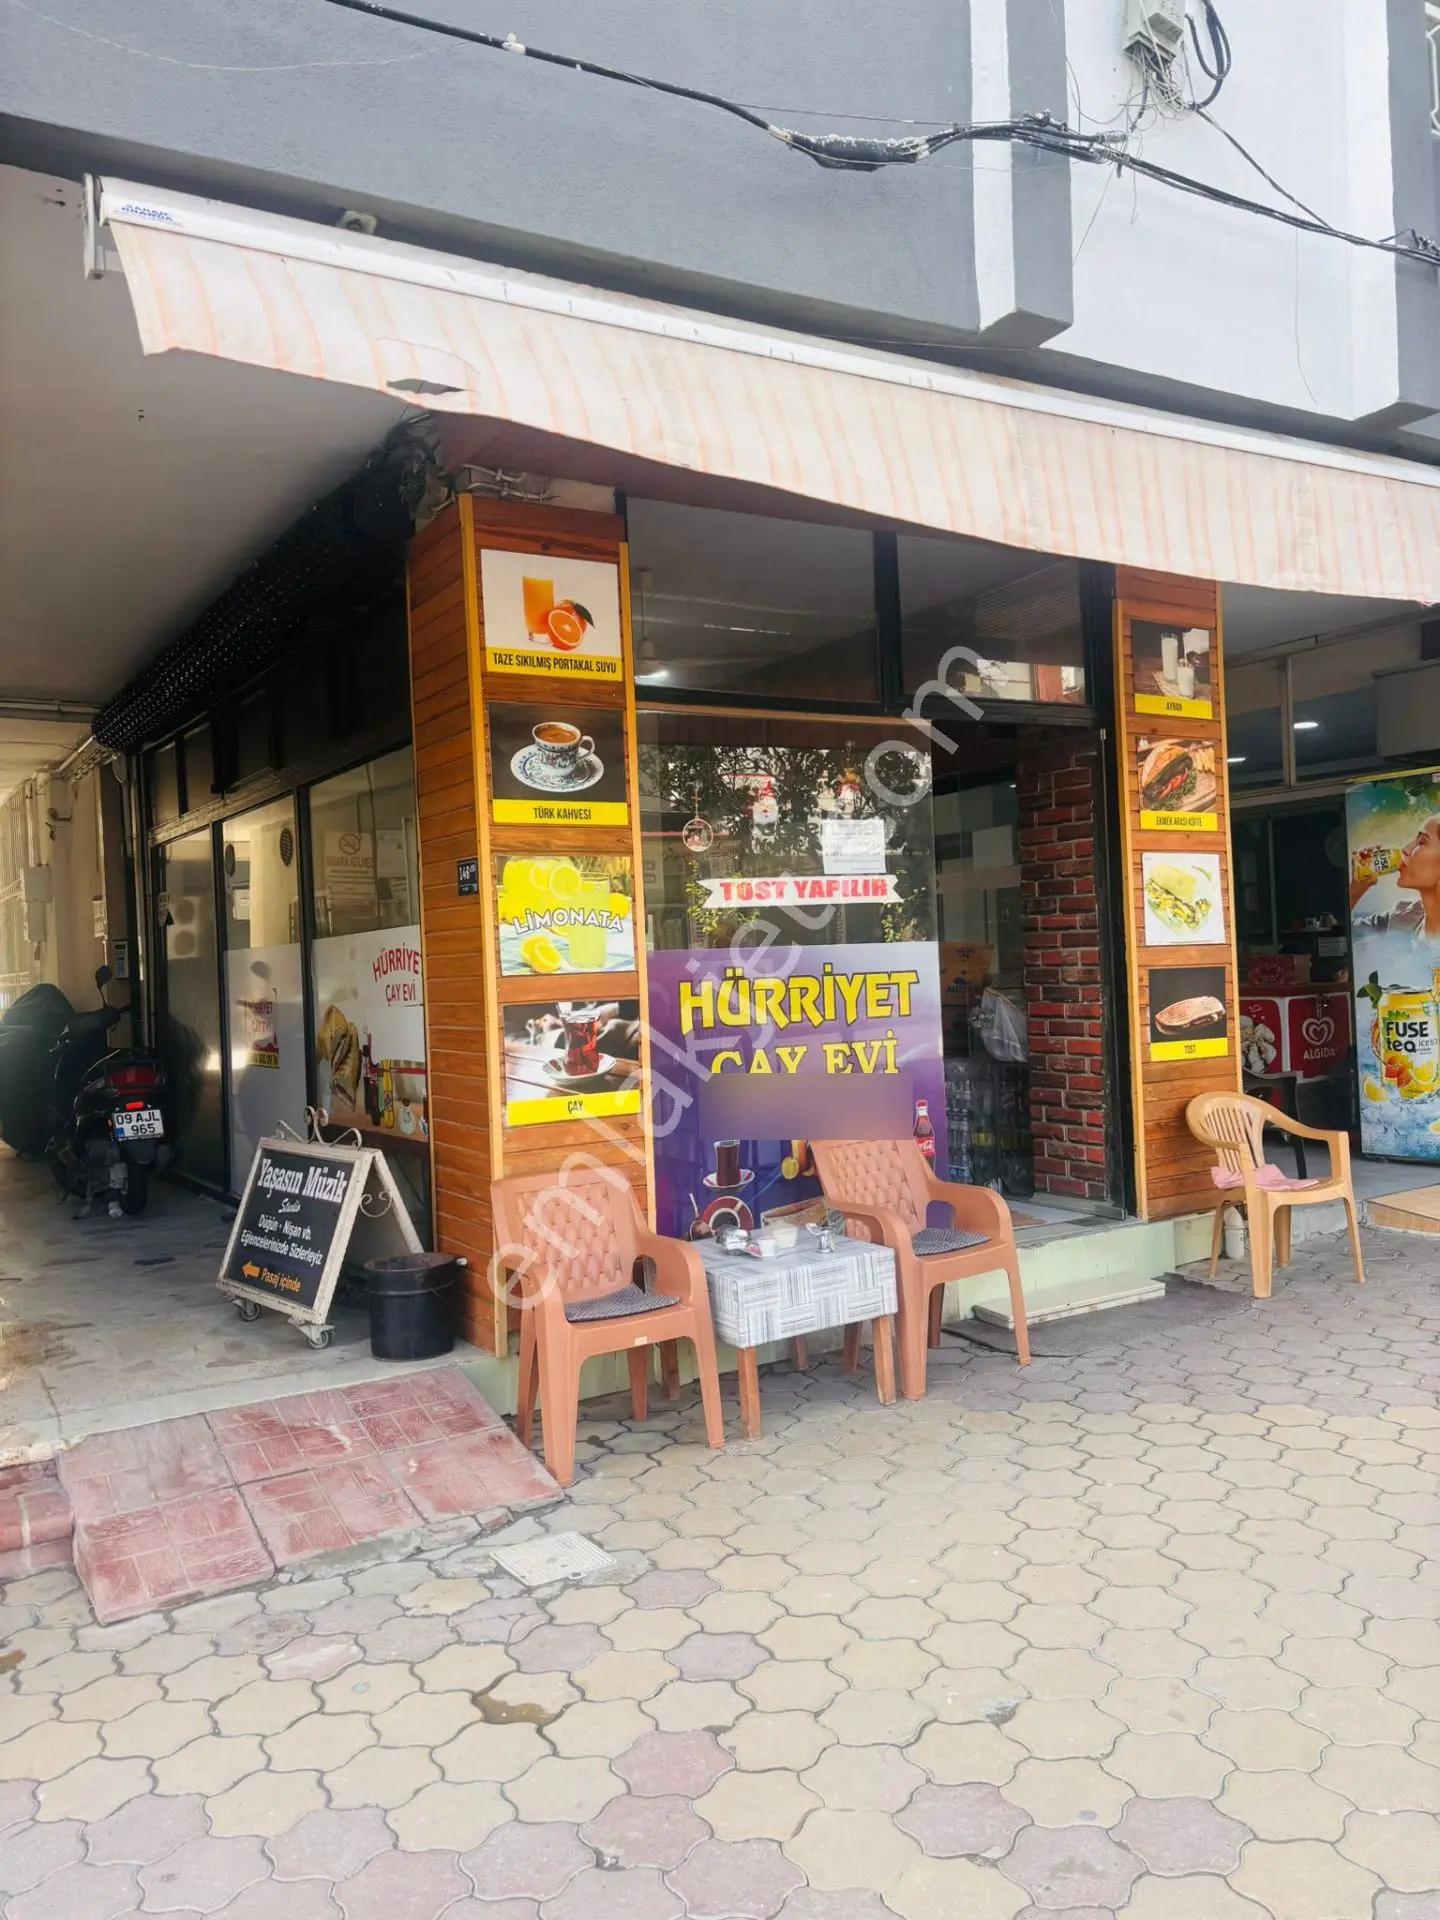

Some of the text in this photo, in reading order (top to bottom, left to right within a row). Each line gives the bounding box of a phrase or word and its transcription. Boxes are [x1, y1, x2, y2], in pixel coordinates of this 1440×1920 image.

[493, 652, 617, 674] TAZE SIKILMIŞ PORTAKAL SUYU
[533, 806, 592, 820] TÜRK KAHVESİ
[719, 878, 888, 902] TOST YAPILIR
[512, 908, 625, 935] LİMONATA
[372, 942, 422, 983] HÜRRİYE
[385, 983, 401, 1008] ÇAY
[678, 962, 920, 1036] HÜRRİYET
[1386, 1021, 1429, 1038] FUSE
[1303, 1047, 1336, 1061] ALGIDA
[1386, 1037, 1417, 1053] tea
[567, 1100, 584, 1115] ÇAY
[115, 1111, 160, 1126] 09 AJL
[130, 1123, 156, 1136] 965
[257, 1157, 348, 1203] Yaşasın Müzik
[260, 1267, 280, 1288] Pasaj
